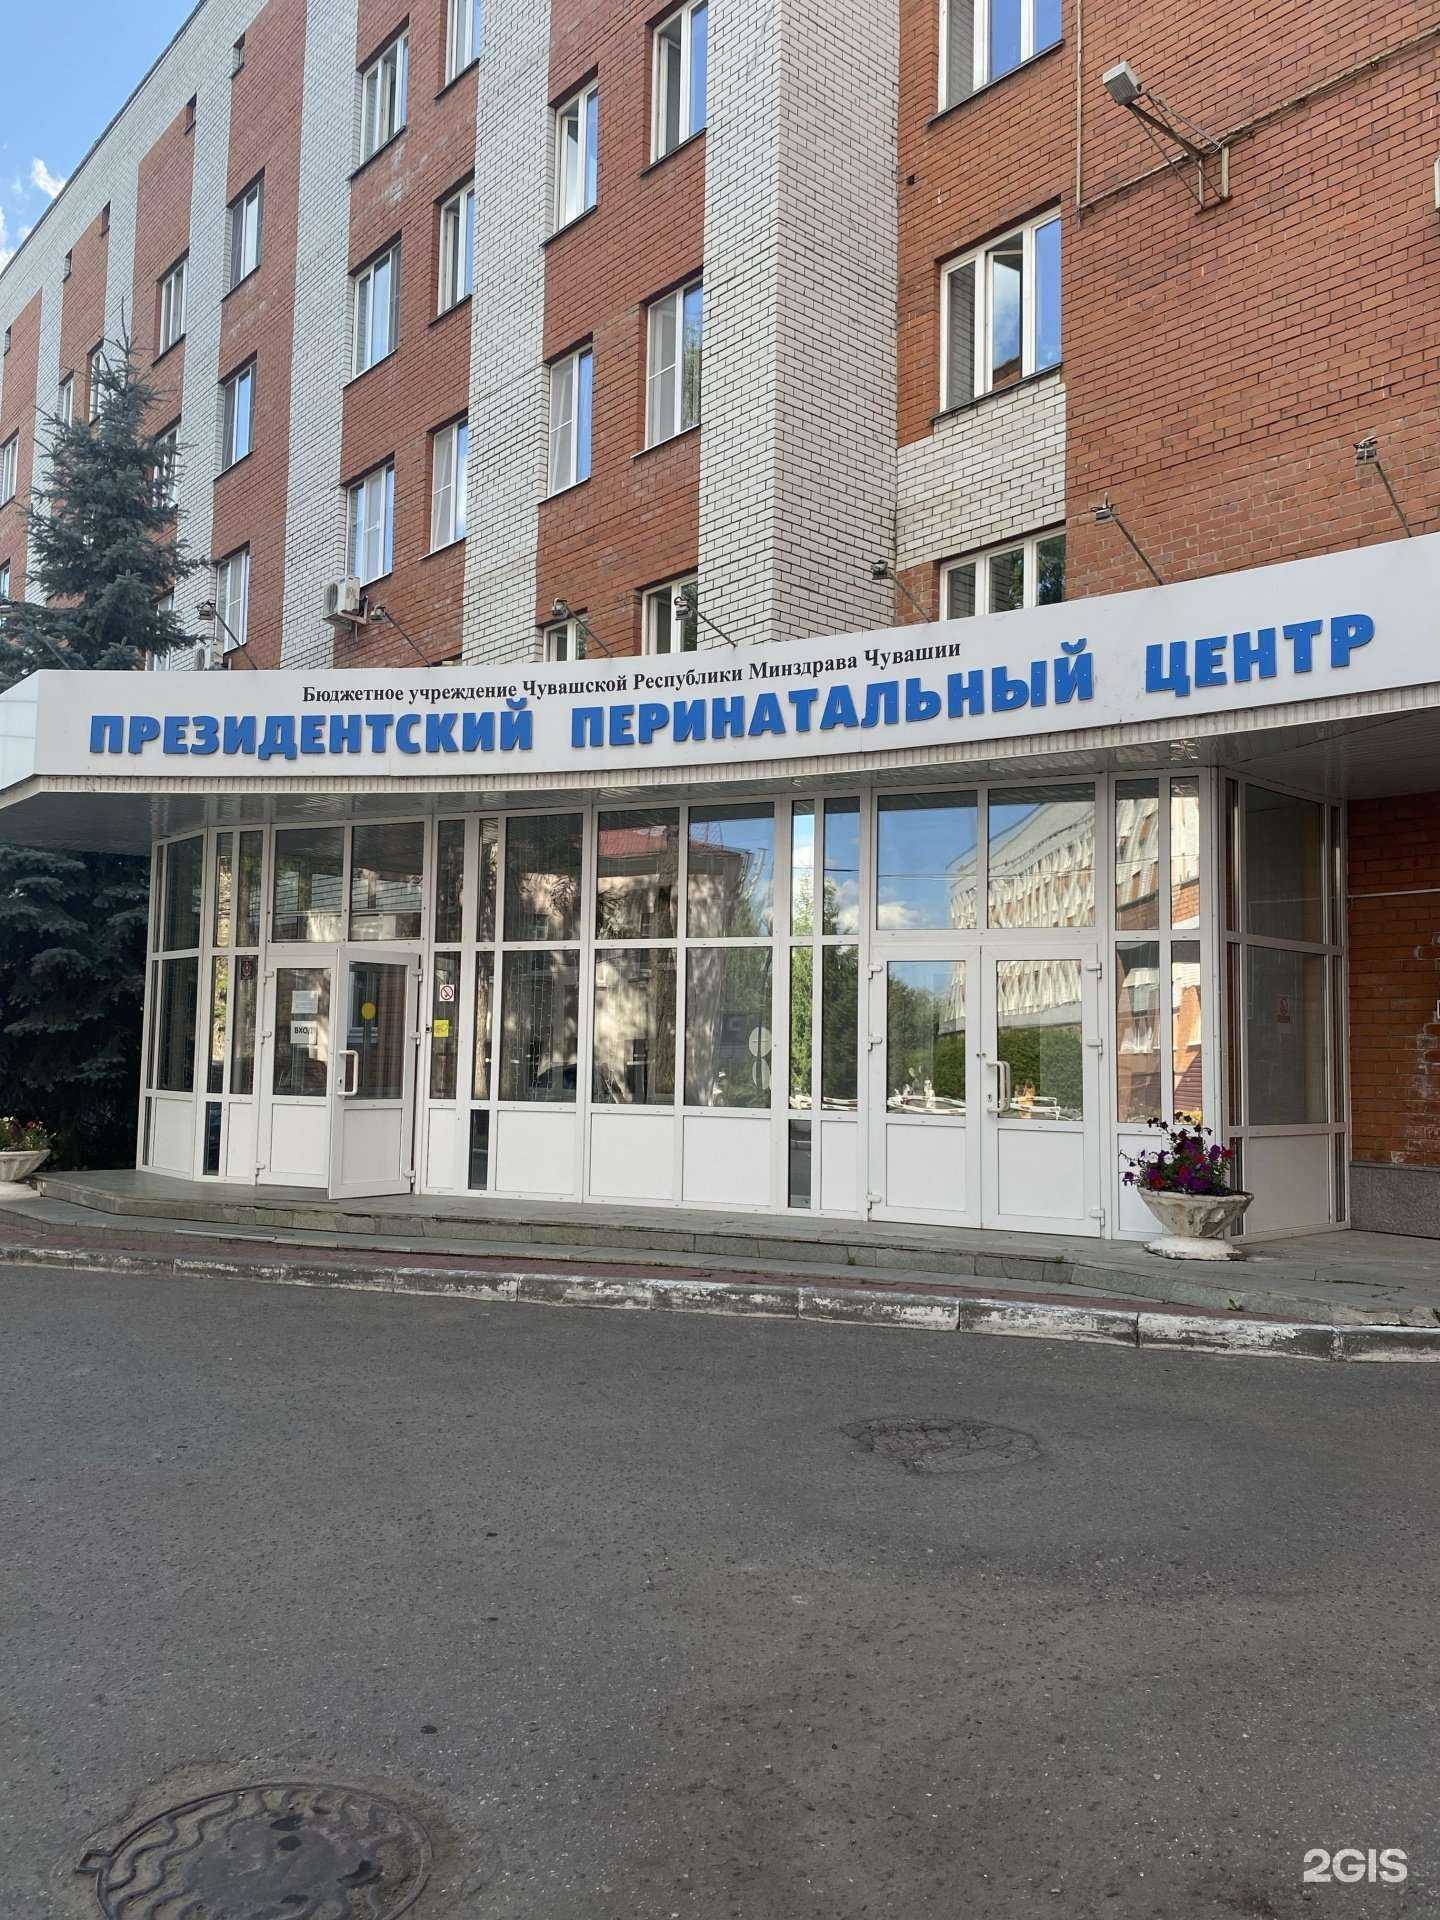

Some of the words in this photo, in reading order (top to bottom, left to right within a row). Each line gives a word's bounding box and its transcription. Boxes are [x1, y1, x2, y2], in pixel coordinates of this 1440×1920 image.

[90, 697, 533, 761] ПРЕЗИДЕНТСКИЙ
[571, 638, 1094, 748] ПЕРИНАТАЛЬНЫЙ
[1145, 613, 1376, 698] ЦЕНТР
[303, 686, 404, 704] Бюджетное
[408, 681, 518, 704] учреждение
[523, 674, 628, 700] Чувашской
[633, 667, 743, 692] Республики
[749, 656, 858, 680] Минздрава
[864, 643, 962, 672] Чувашии
